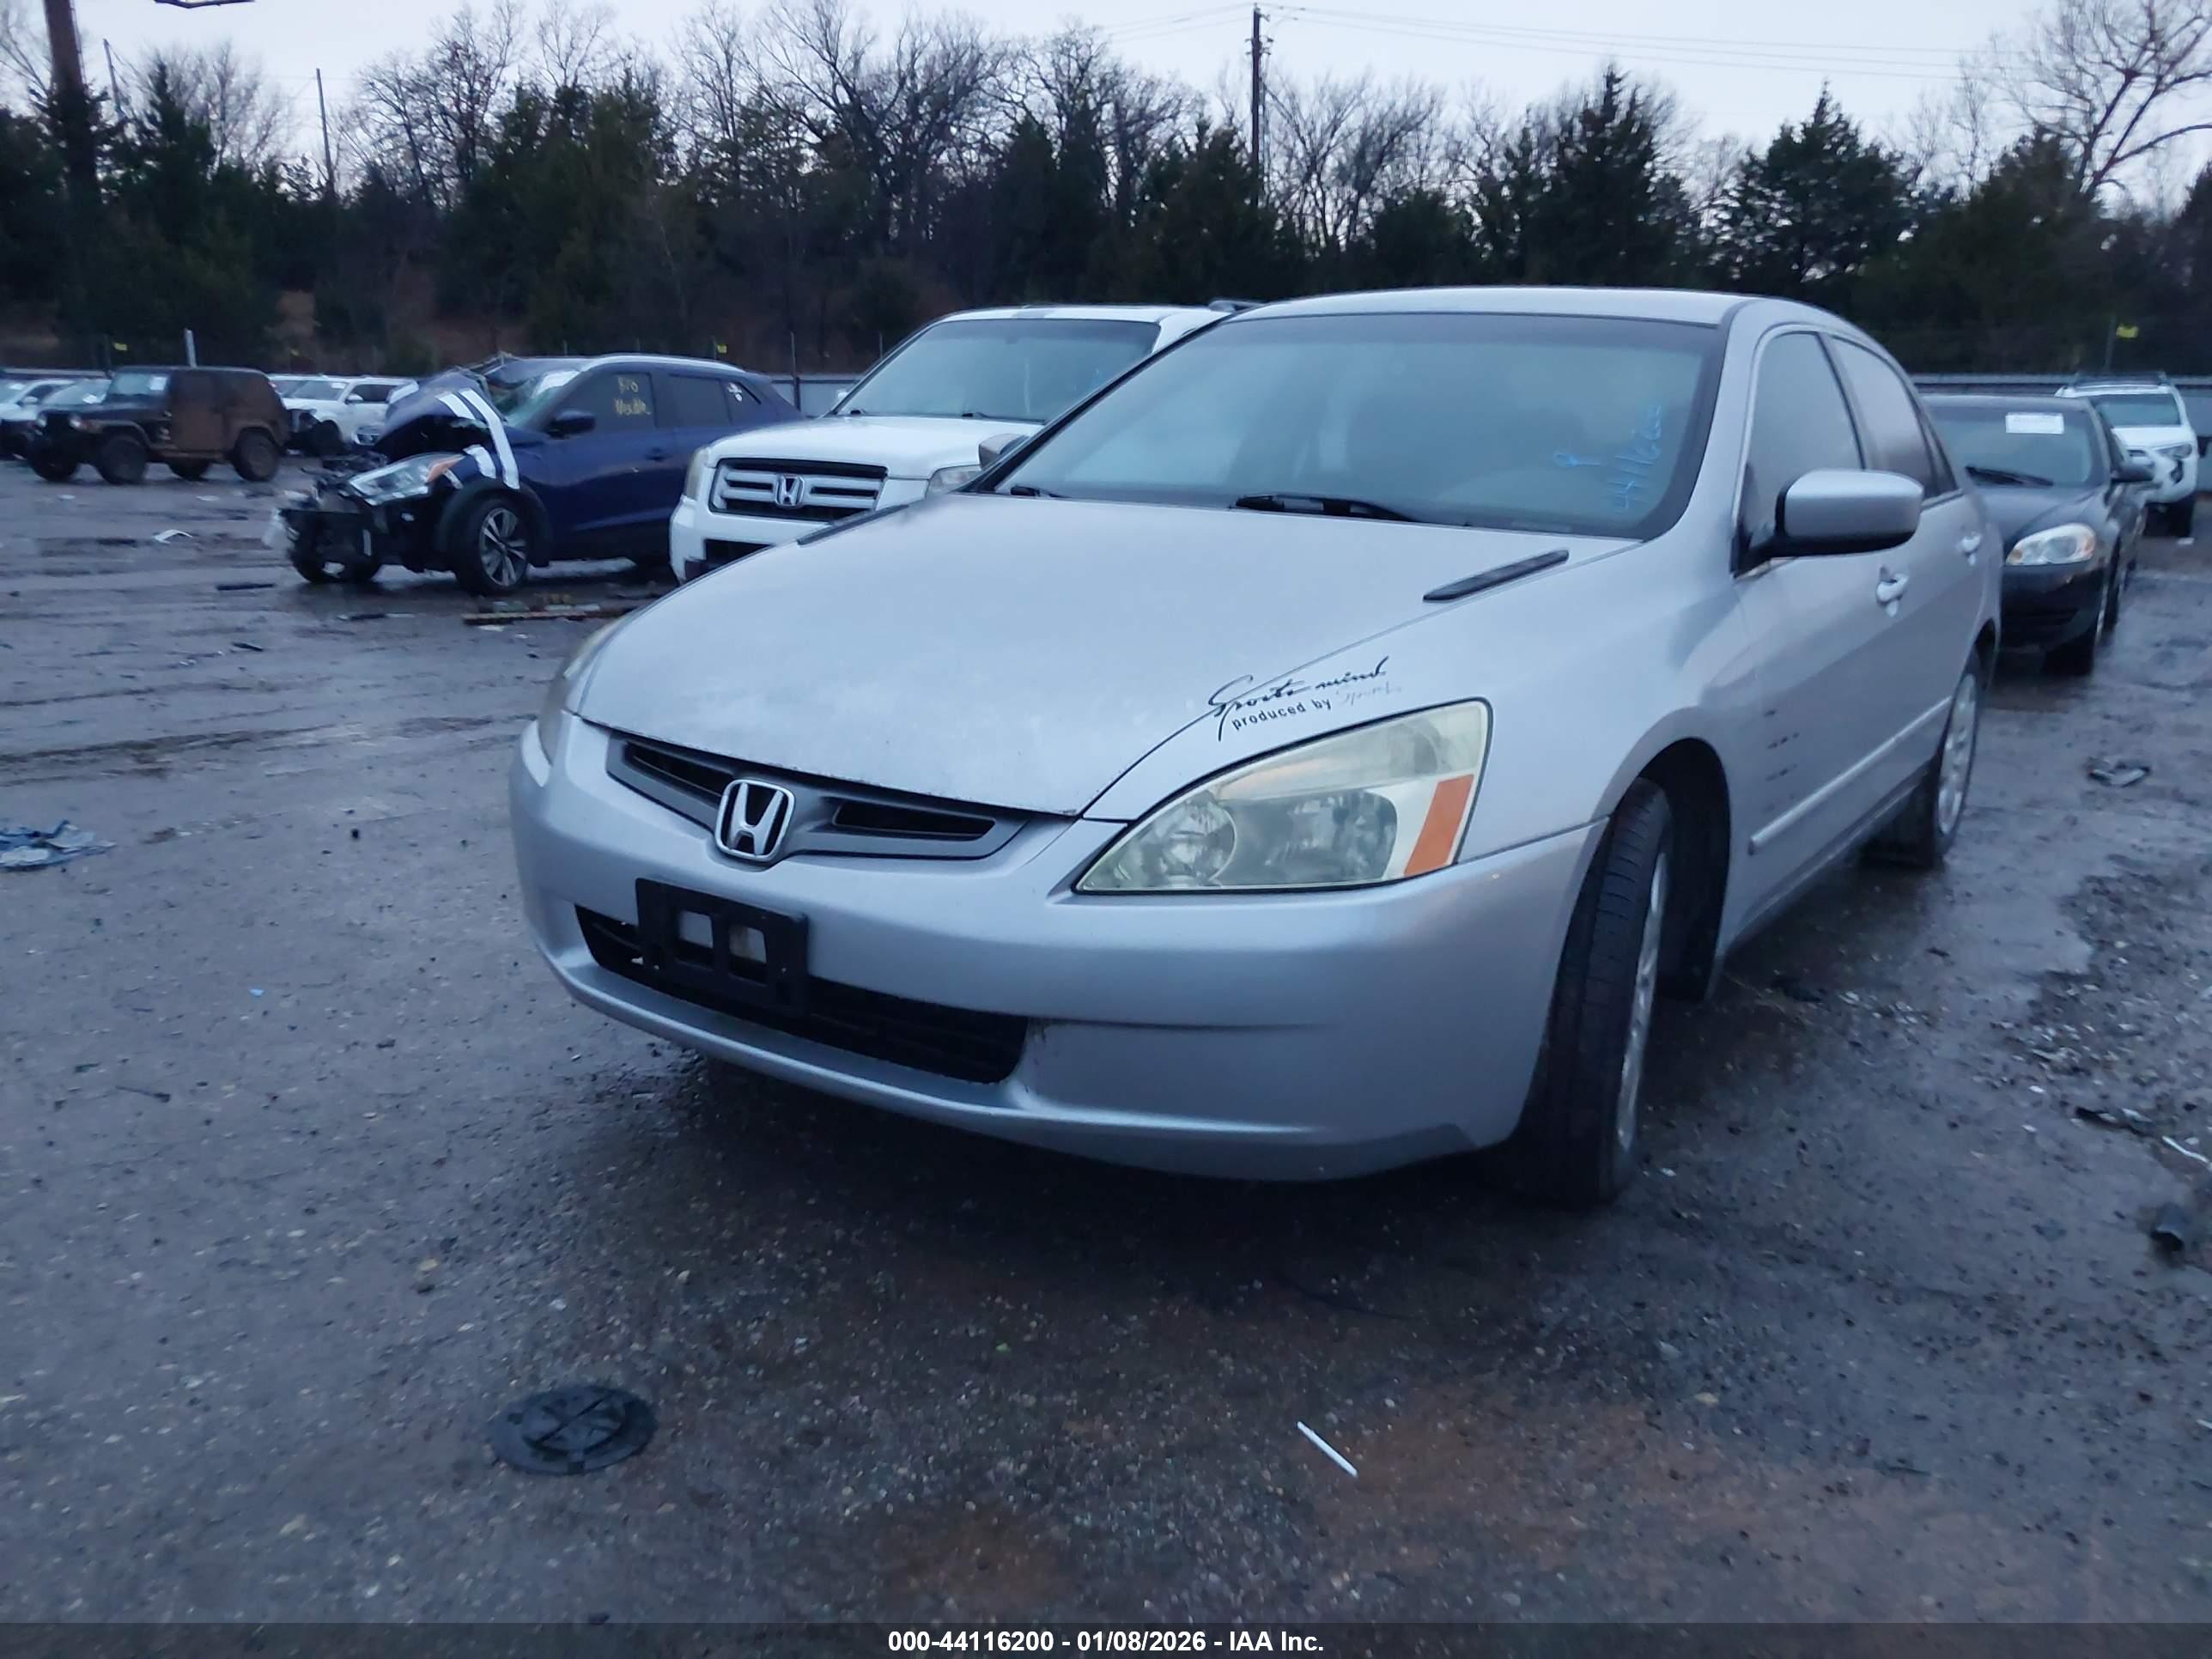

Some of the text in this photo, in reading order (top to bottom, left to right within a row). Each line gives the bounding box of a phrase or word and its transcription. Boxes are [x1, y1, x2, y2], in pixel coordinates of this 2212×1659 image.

[1315, 655, 1389, 690] mind
[1231, 698, 1332, 731] produced by
